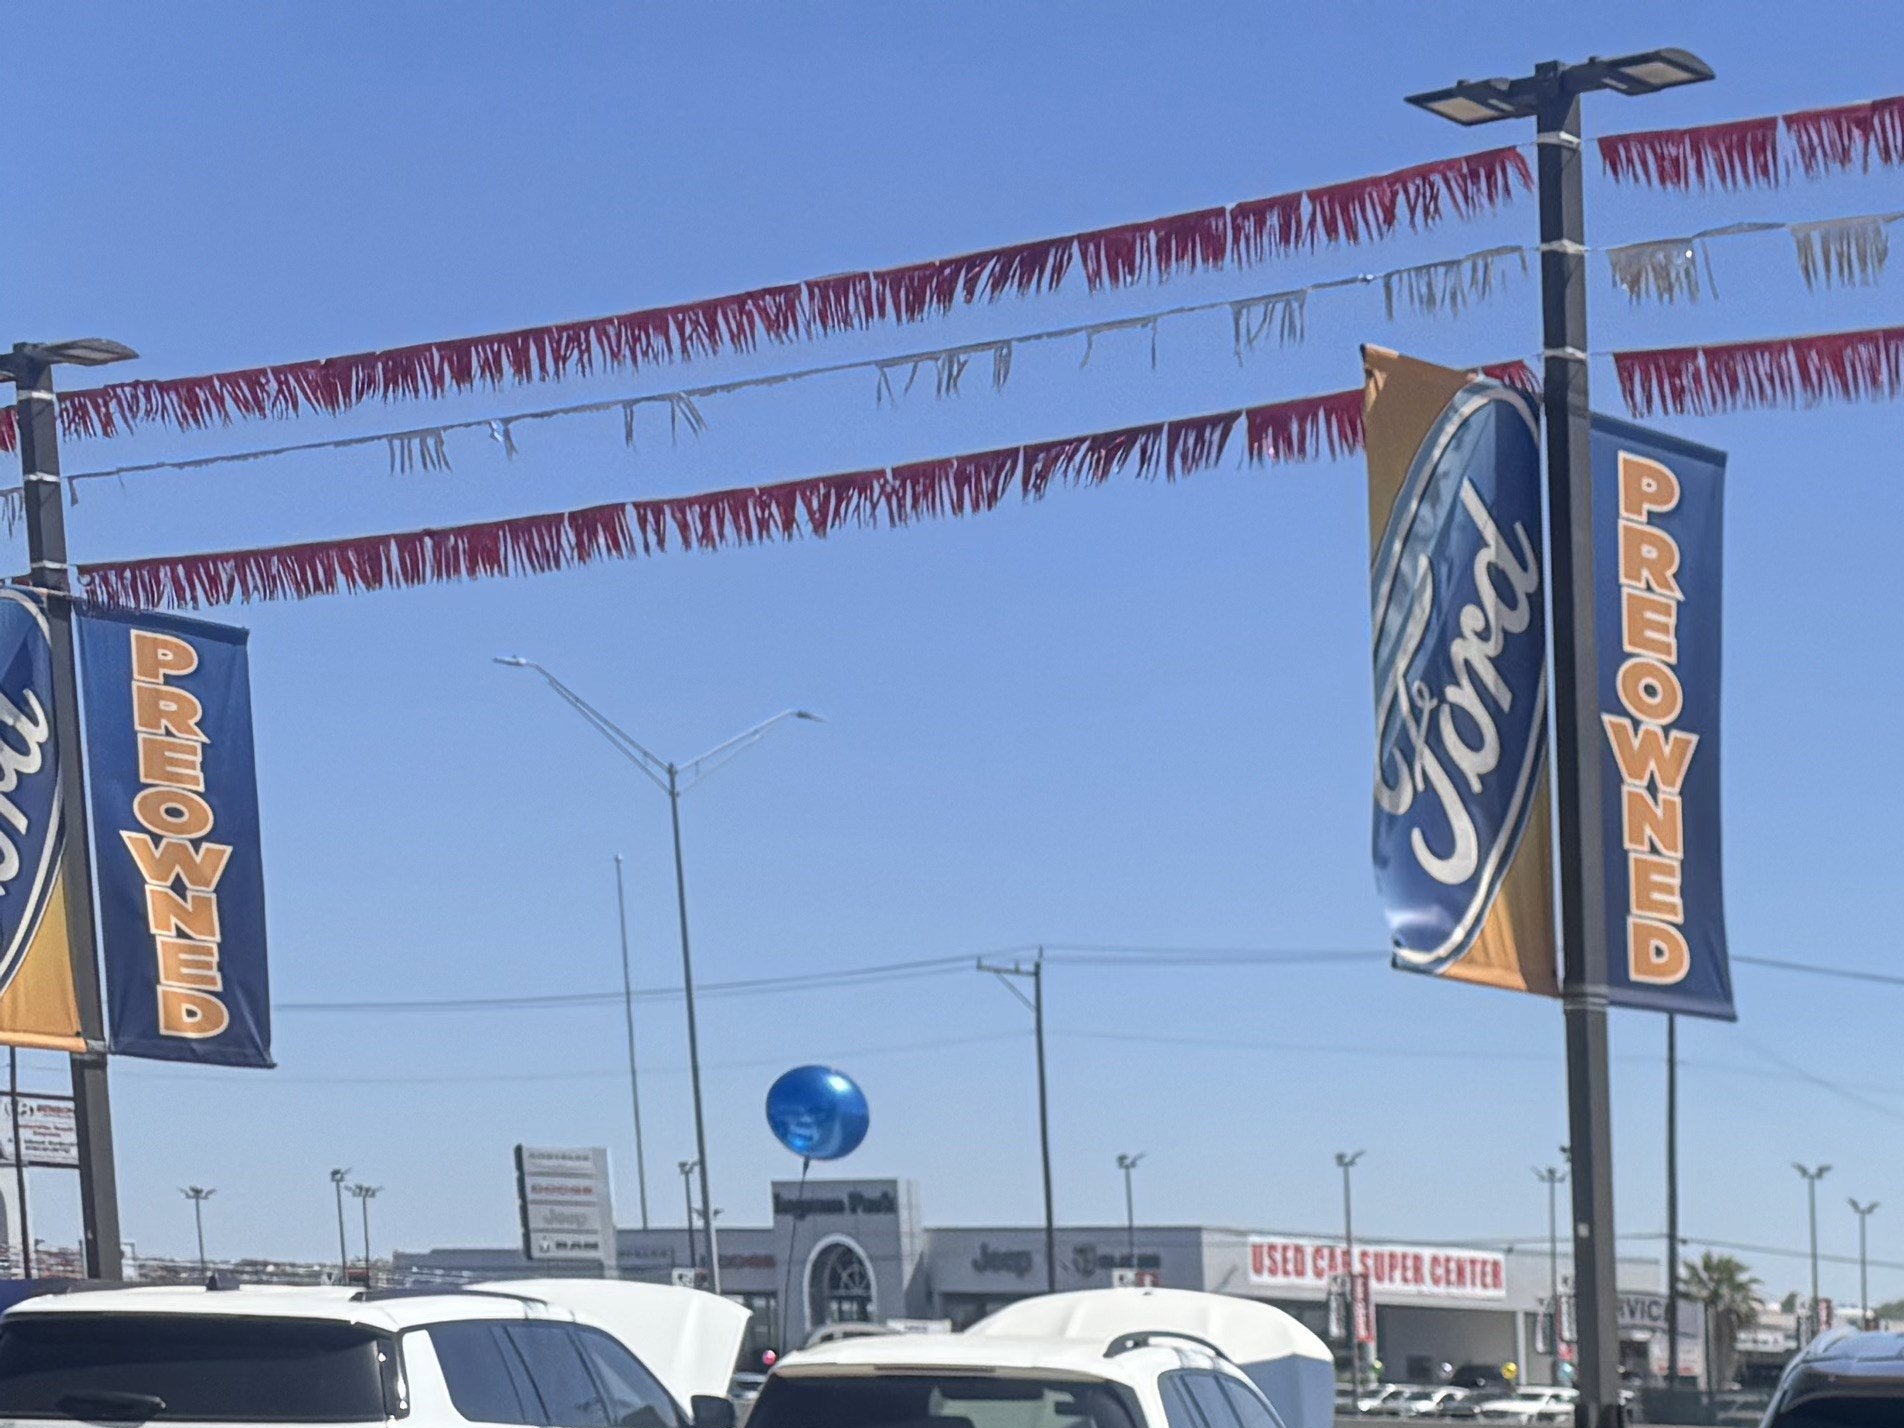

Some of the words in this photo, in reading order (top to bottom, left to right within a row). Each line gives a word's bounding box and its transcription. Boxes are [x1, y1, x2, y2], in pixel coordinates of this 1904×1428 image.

[119, 628, 233, 1040] PREOWNED
[1376, 477, 1540, 885] Ford
[1601, 450, 1699, 986] PREOWNED
[1251, 1243, 1306, 1278] USED
[1358, 1249, 1425, 1284] SUPER
[1430, 1254, 1503, 1290] CENTER
